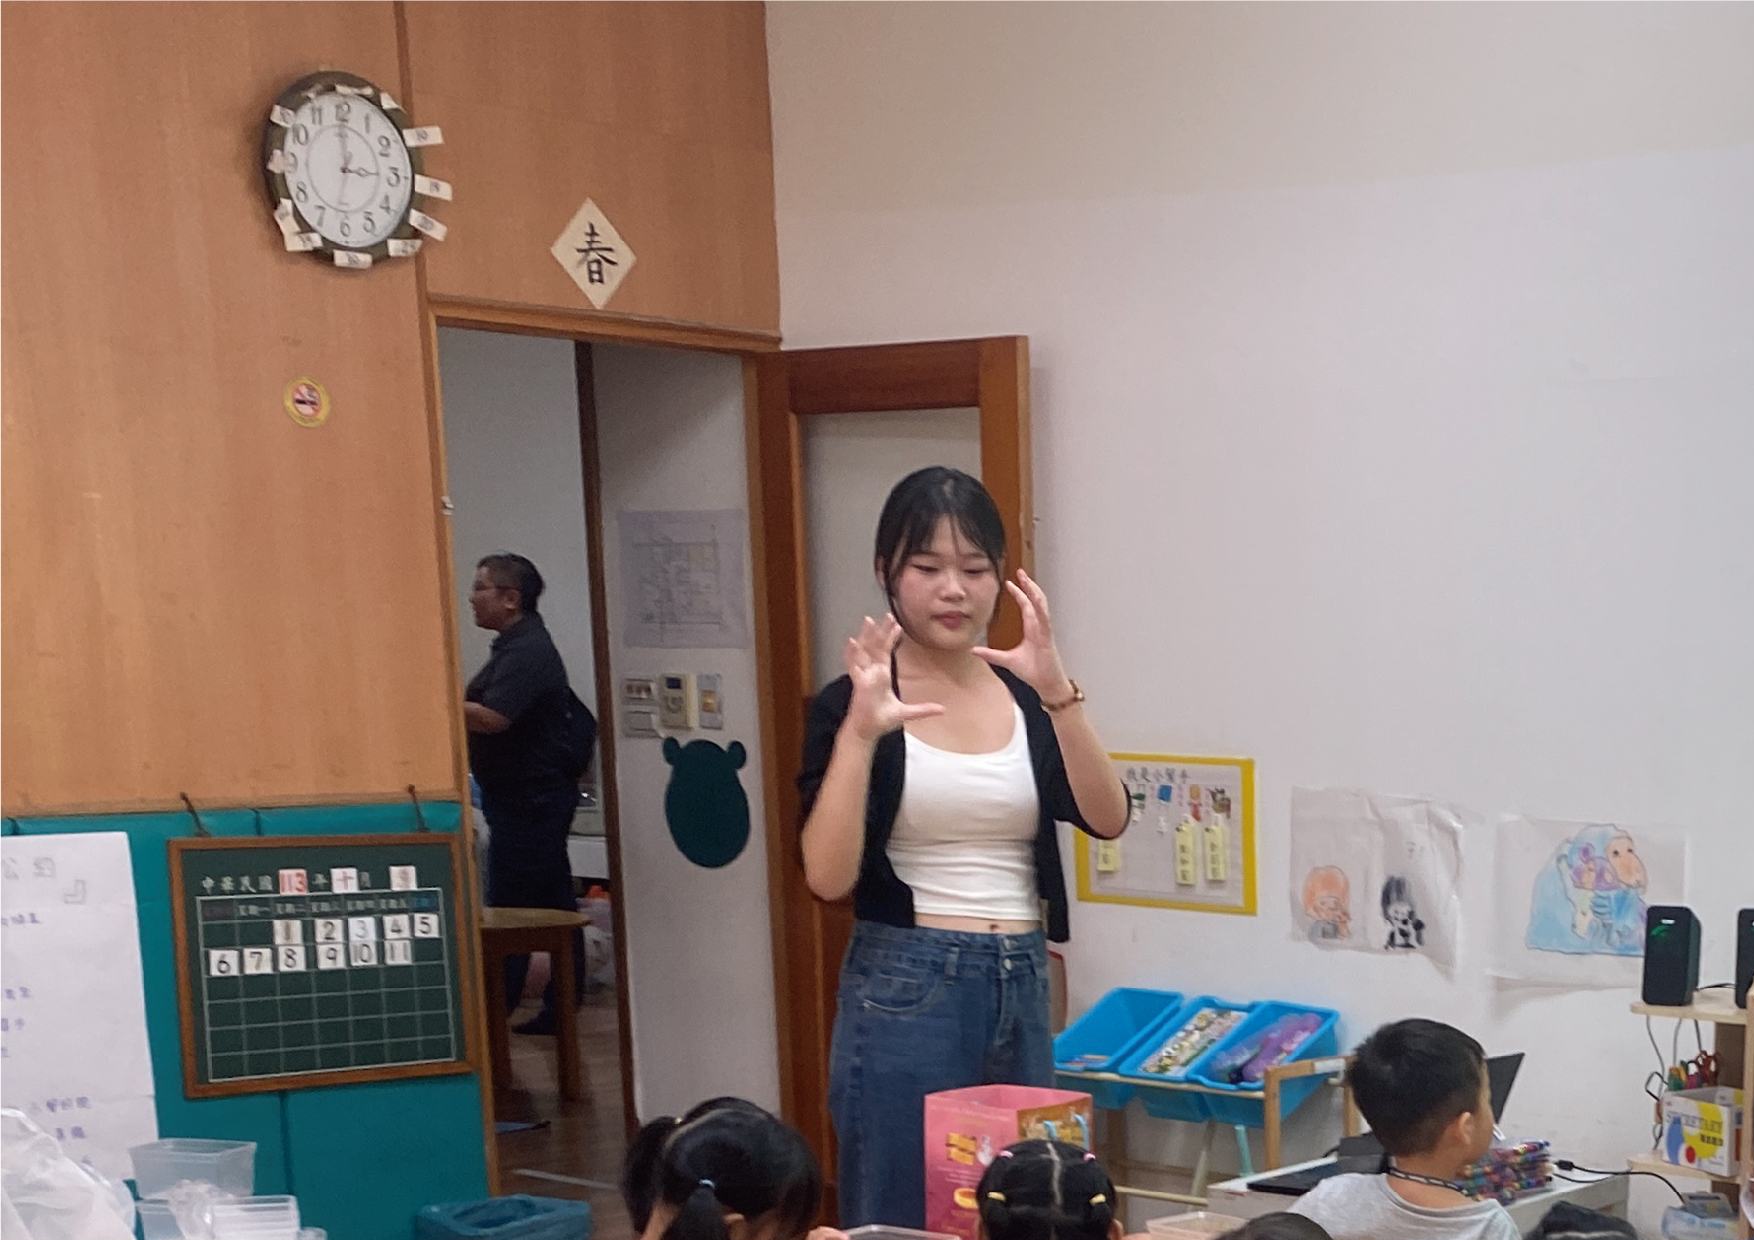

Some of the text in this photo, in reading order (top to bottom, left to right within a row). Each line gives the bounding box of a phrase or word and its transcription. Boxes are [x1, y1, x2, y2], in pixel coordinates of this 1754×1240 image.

[378, 135, 391, 157] 2
[387, 167, 400, 187] 3
[314, 205, 326, 228] 7
[340, 215, 350, 237] 6
[363, 211, 376, 235] 5
[575, 221, 618, 284] 春
[322, 920, 336, 941] 2
[355, 919, 368, 939] 3
[390, 917, 403, 934] 4
[419, 915, 432, 935] 5
[217, 943, 409, 974] 6 7 8 9 10 11
